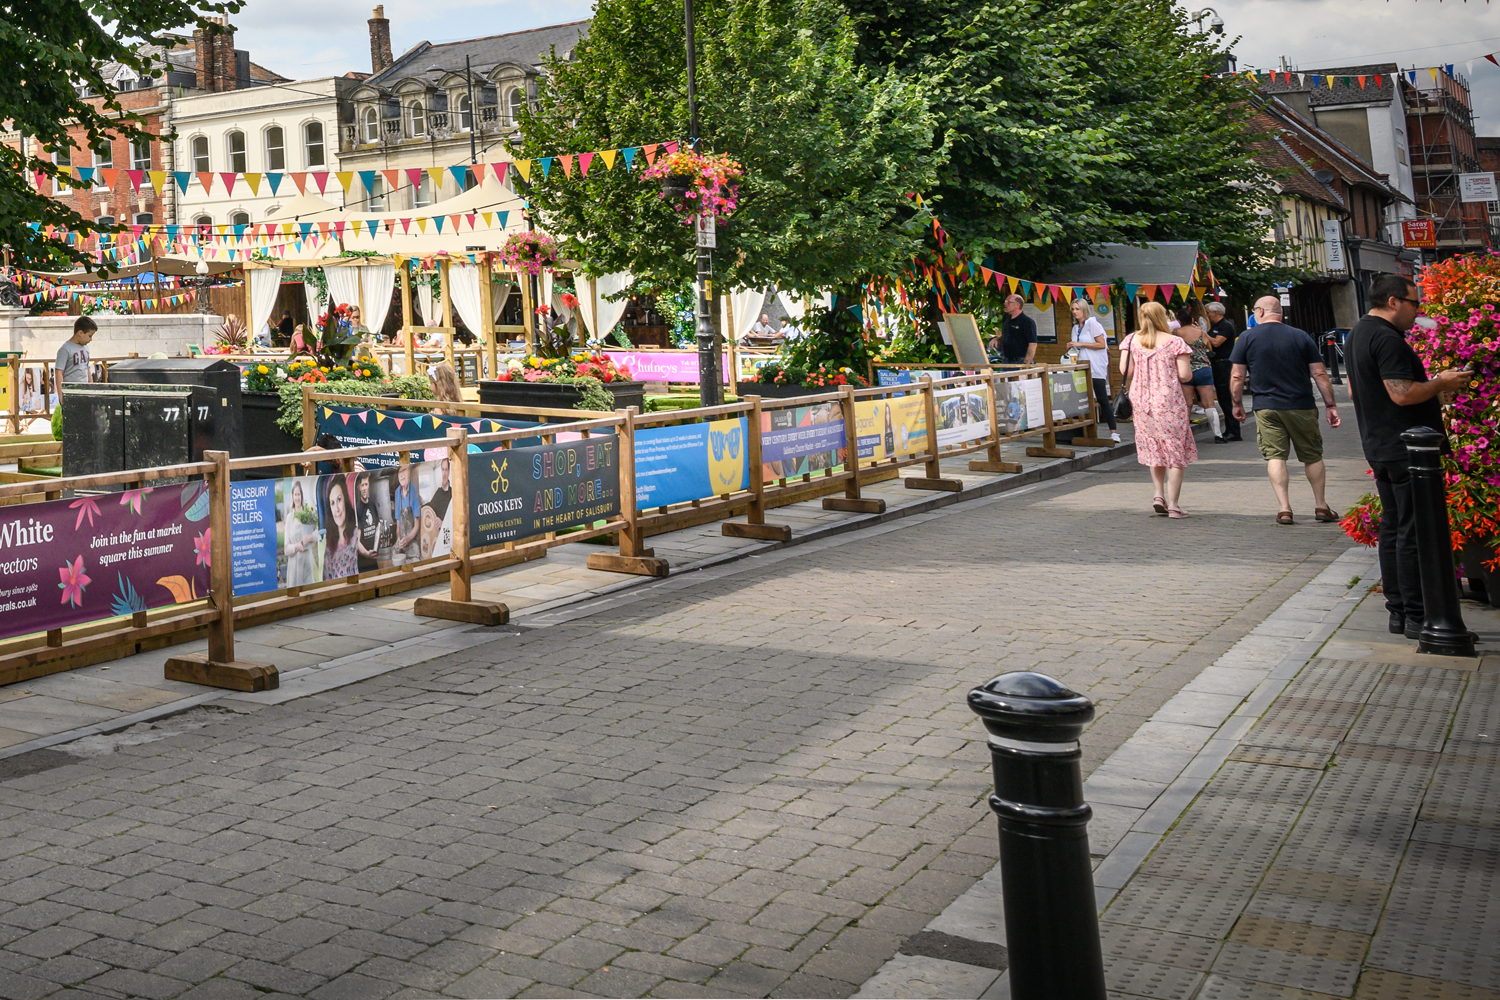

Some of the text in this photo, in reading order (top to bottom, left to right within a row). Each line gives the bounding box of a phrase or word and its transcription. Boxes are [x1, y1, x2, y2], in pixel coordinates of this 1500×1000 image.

[1330, 238, 1340, 262] bistro
[73, 350, 90, 365] GA
[163, 408, 180, 421] 77
[197, 406, 209, 420] 77
[343, 436, 377, 445] remember
[532, 448, 580, 479] SHOP,
[586, 442, 612, 471] EAT
[231, 486, 269, 500] SALISBURY
[534, 487, 563, 512] AND
[232, 499, 257, 512] STREET
[477, 497, 523, 516] CROSS KEYS
[232, 511, 263, 525] SELLERS
[533, 502, 613, 529] IN THE HEART OF SALISBURY
[478, 518, 522, 532] SHOPPING CENTRE
[90, 523, 182, 549] Join in the fun at market
[486, 530, 517, 540] SALISBURY
[99, 543, 173, 567] square this summer
[12, 585, 25, 595] since
[25, 584, 38, 593] 1982
